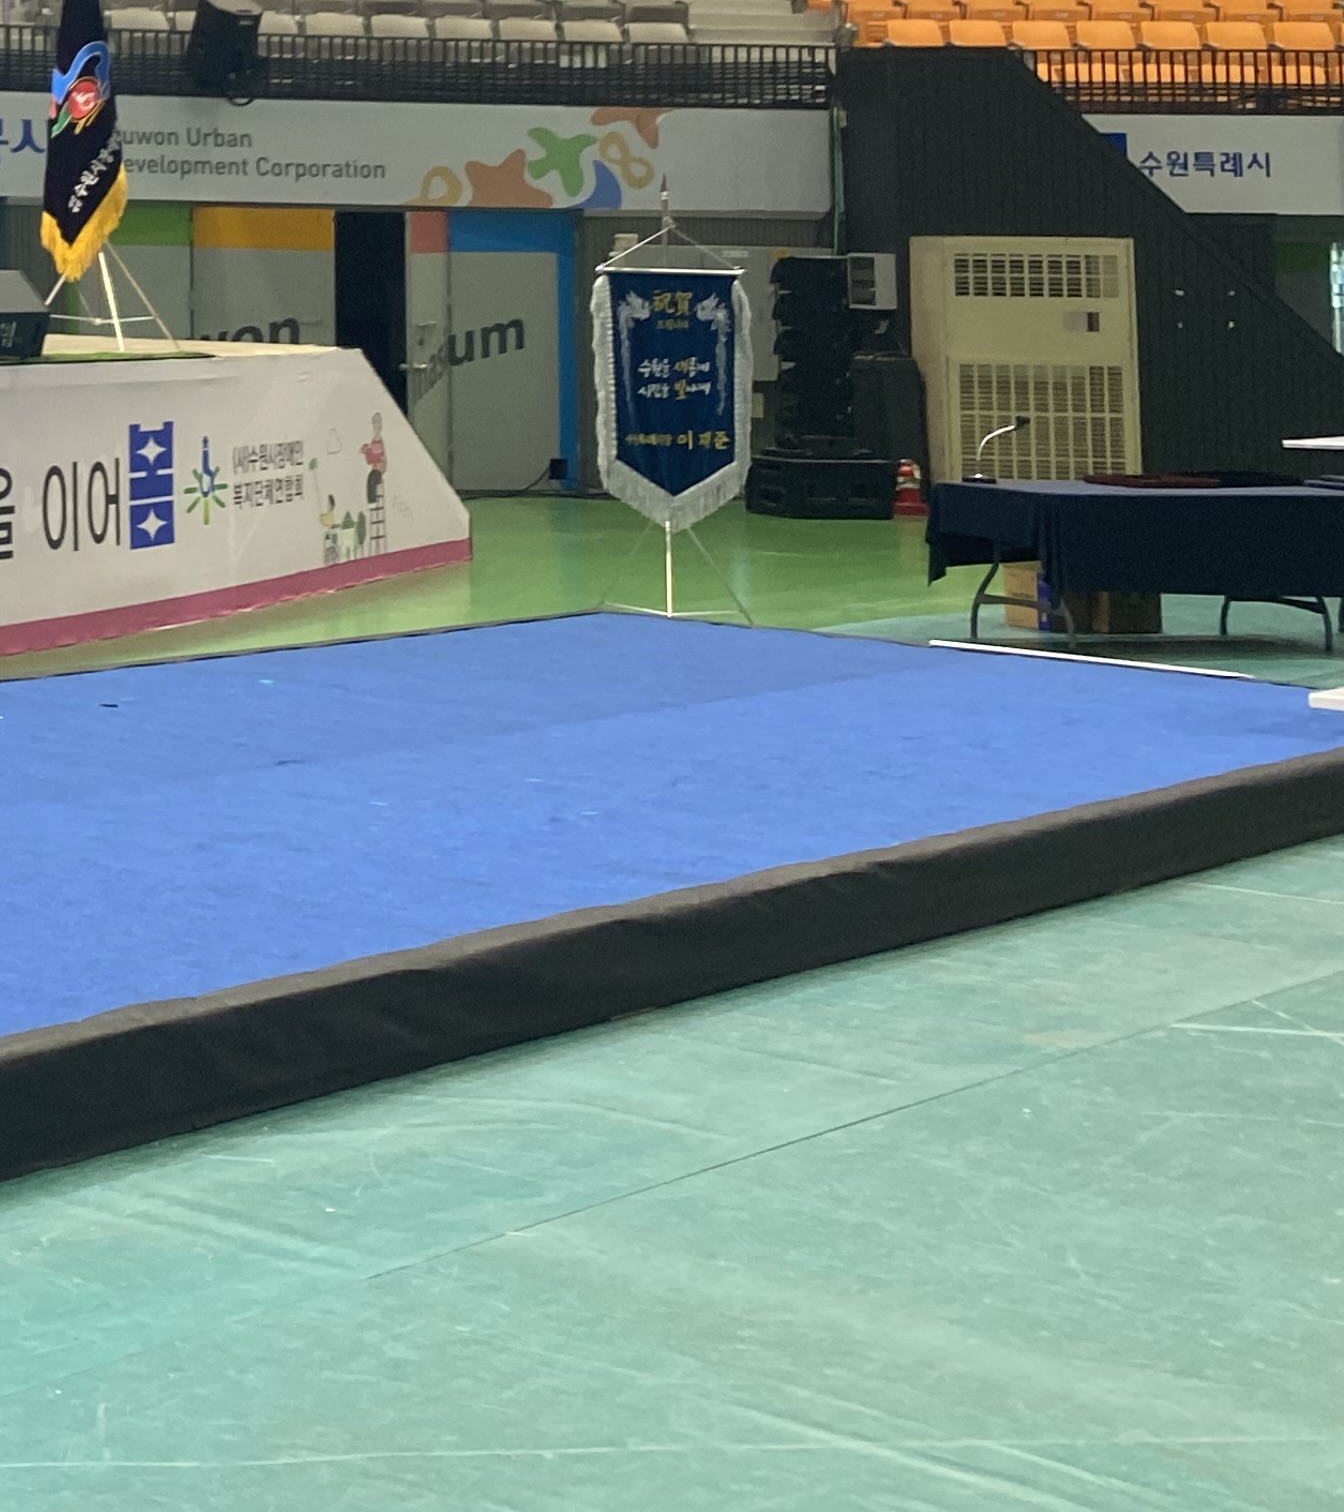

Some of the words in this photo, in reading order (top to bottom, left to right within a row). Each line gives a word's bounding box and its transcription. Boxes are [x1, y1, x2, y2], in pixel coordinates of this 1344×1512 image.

[185, 127, 253, 149] Urban
[124, 154, 249, 179] evelopment
[255, 156, 386, 182] Corporation
[1138, 150, 1272, 179] 수원특례시
[42, 420, 175, 552] 이어봄
